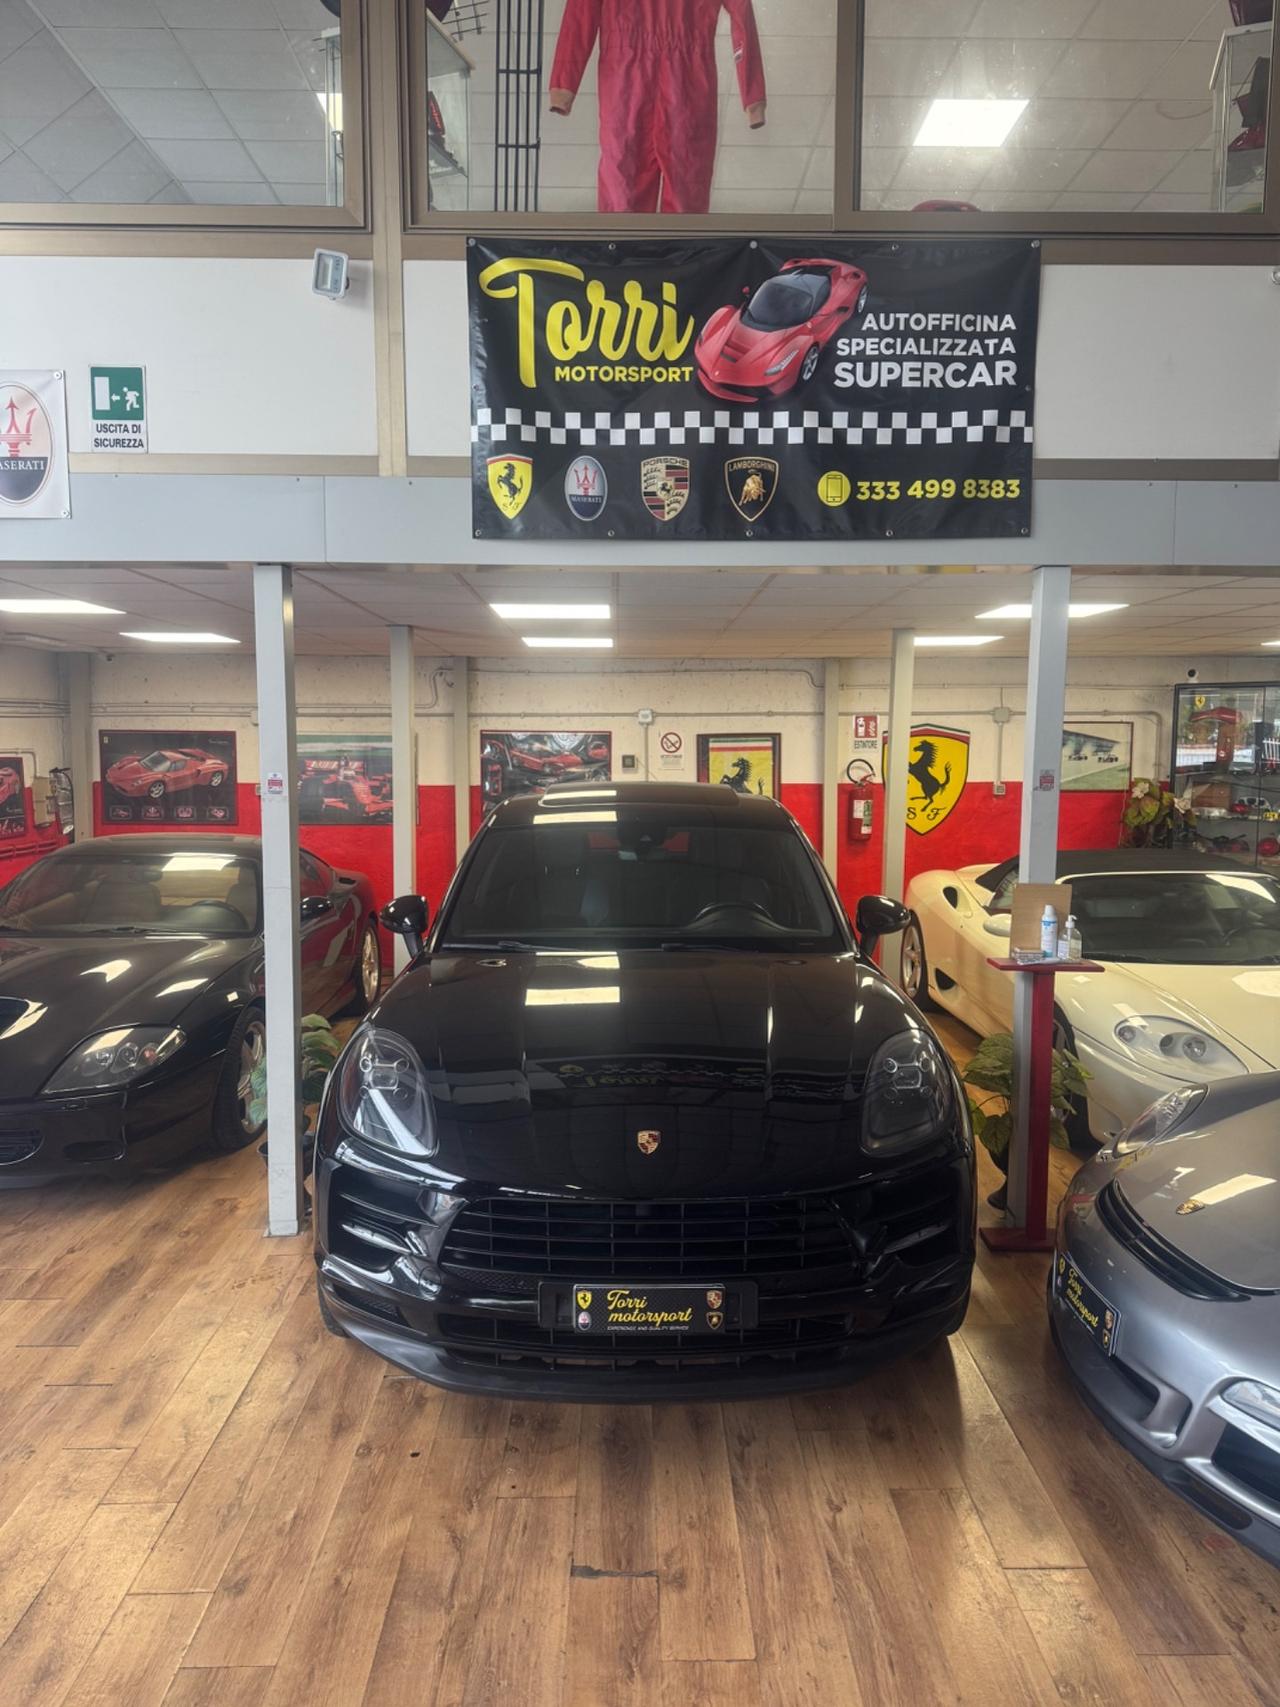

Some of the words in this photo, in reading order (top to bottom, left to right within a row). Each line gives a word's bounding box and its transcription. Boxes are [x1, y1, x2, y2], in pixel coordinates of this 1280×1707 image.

[479, 257, 695, 388] Torri
[861, 313, 1017, 332] AUTOFFICINA
[836, 337, 1017, 356] SPECIALIZZATA
[555, 366, 694, 382] MOTORSPORT
[833, 360, 1018, 389] SUPERCAR
[96, 423, 130, 434] USCITA
[131, 423, 141, 434] DI
[94, 438, 144, 449] SICUREZZA
[728, 460, 776, 472] LAMBORGHINI
[856, 481, 900, 500] 333
[907, 479, 956, 499] 499
[962, 479, 1021, 499] 8383
[607, 1289, 648, 1310] Torri
[608, 1307, 693, 1327] motorsport
